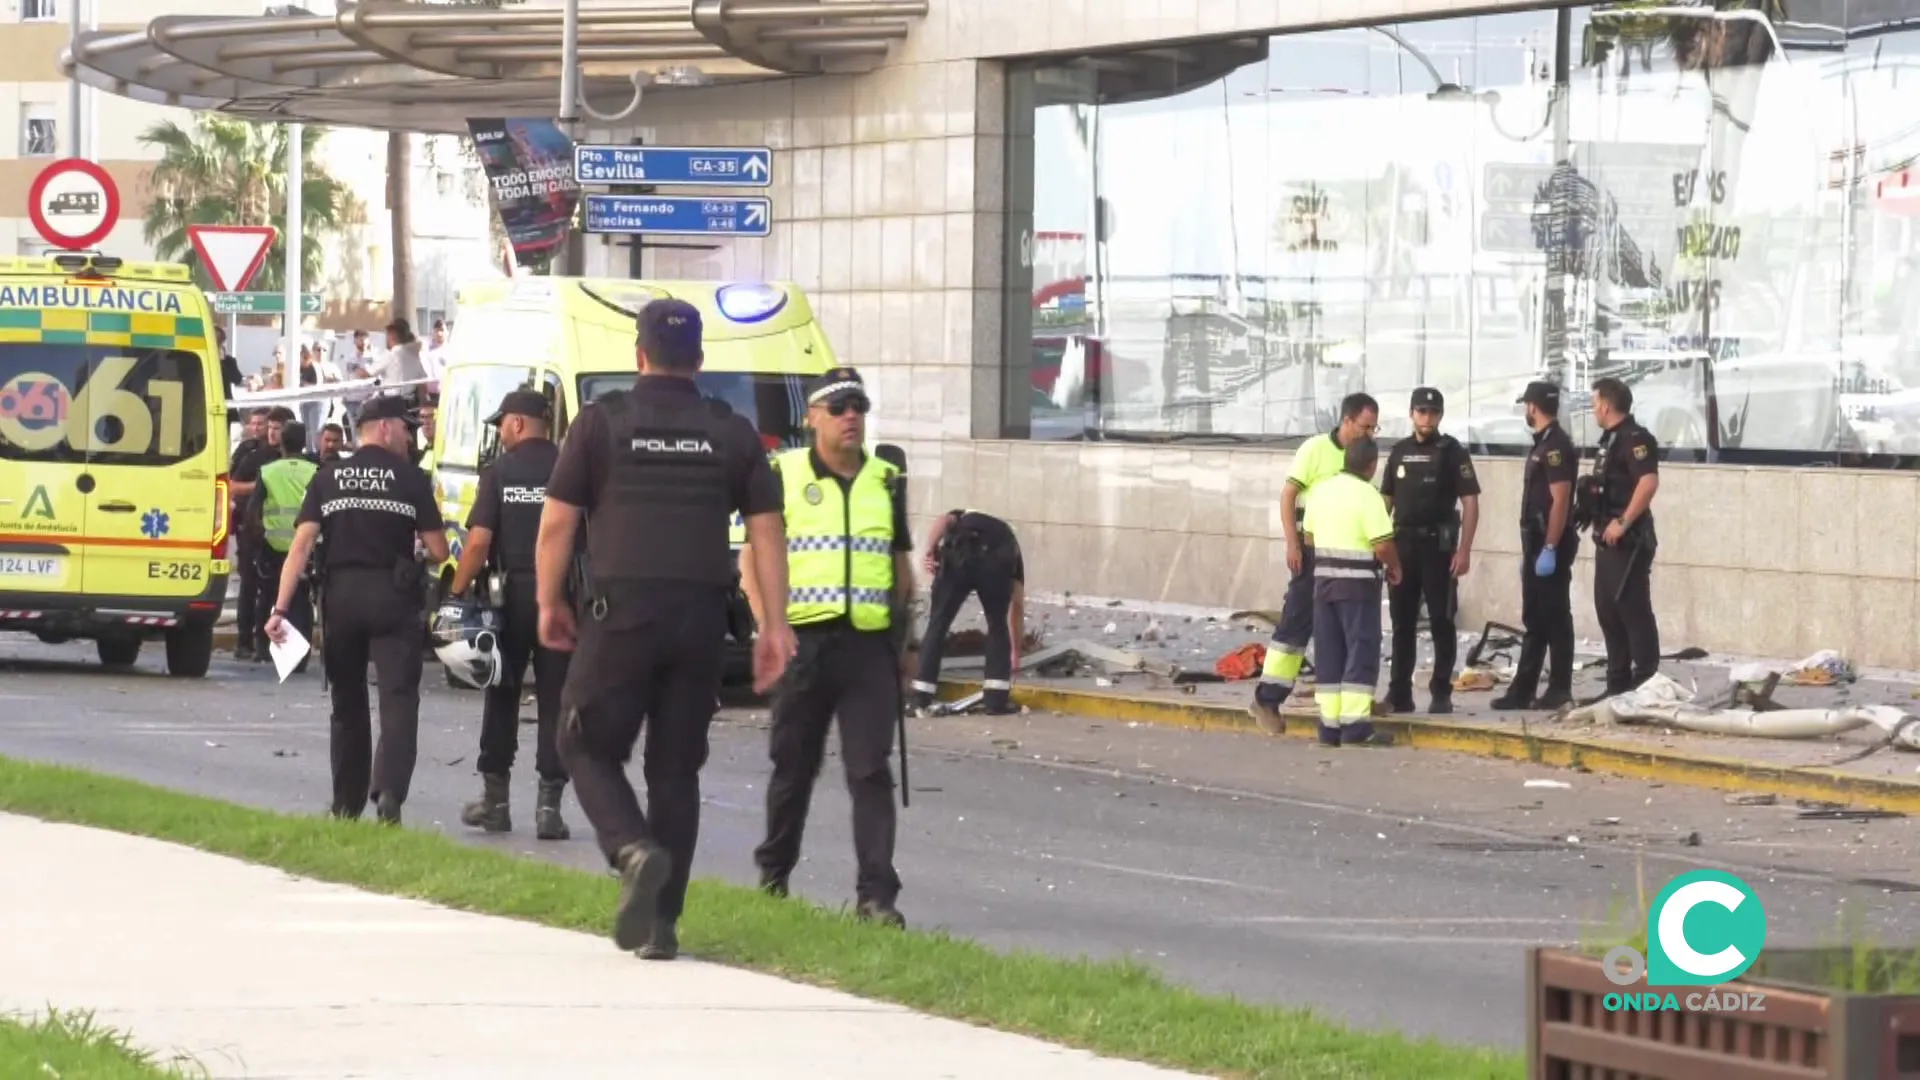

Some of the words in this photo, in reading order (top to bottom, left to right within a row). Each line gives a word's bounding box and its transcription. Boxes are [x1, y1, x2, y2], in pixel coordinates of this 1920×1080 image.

[580, 151, 607, 162] Pto.
[614, 152, 644, 162] Real
[581, 163, 645, 179] Sevilla
[692, 160, 736, 173] CA-35
[491, 172, 527, 189] TODO
[528, 164, 574, 182] EMOCIÓ
[497, 185, 531, 200] TODA
[532, 182, 547, 195] EN
[613, 201, 675, 214] Fernando
[589, 215, 642, 227] Algeciras
[0, 285, 182, 314] AMBULANCIA
[631, 439, 713, 453] POLICIA
[339, 479, 389, 491] LOCAL
[503, 486, 547, 495] POLIC
[503, 495, 546, 503] NACIO
[27, 559, 54, 573] LVF
[148, 561, 202, 580] E-262
